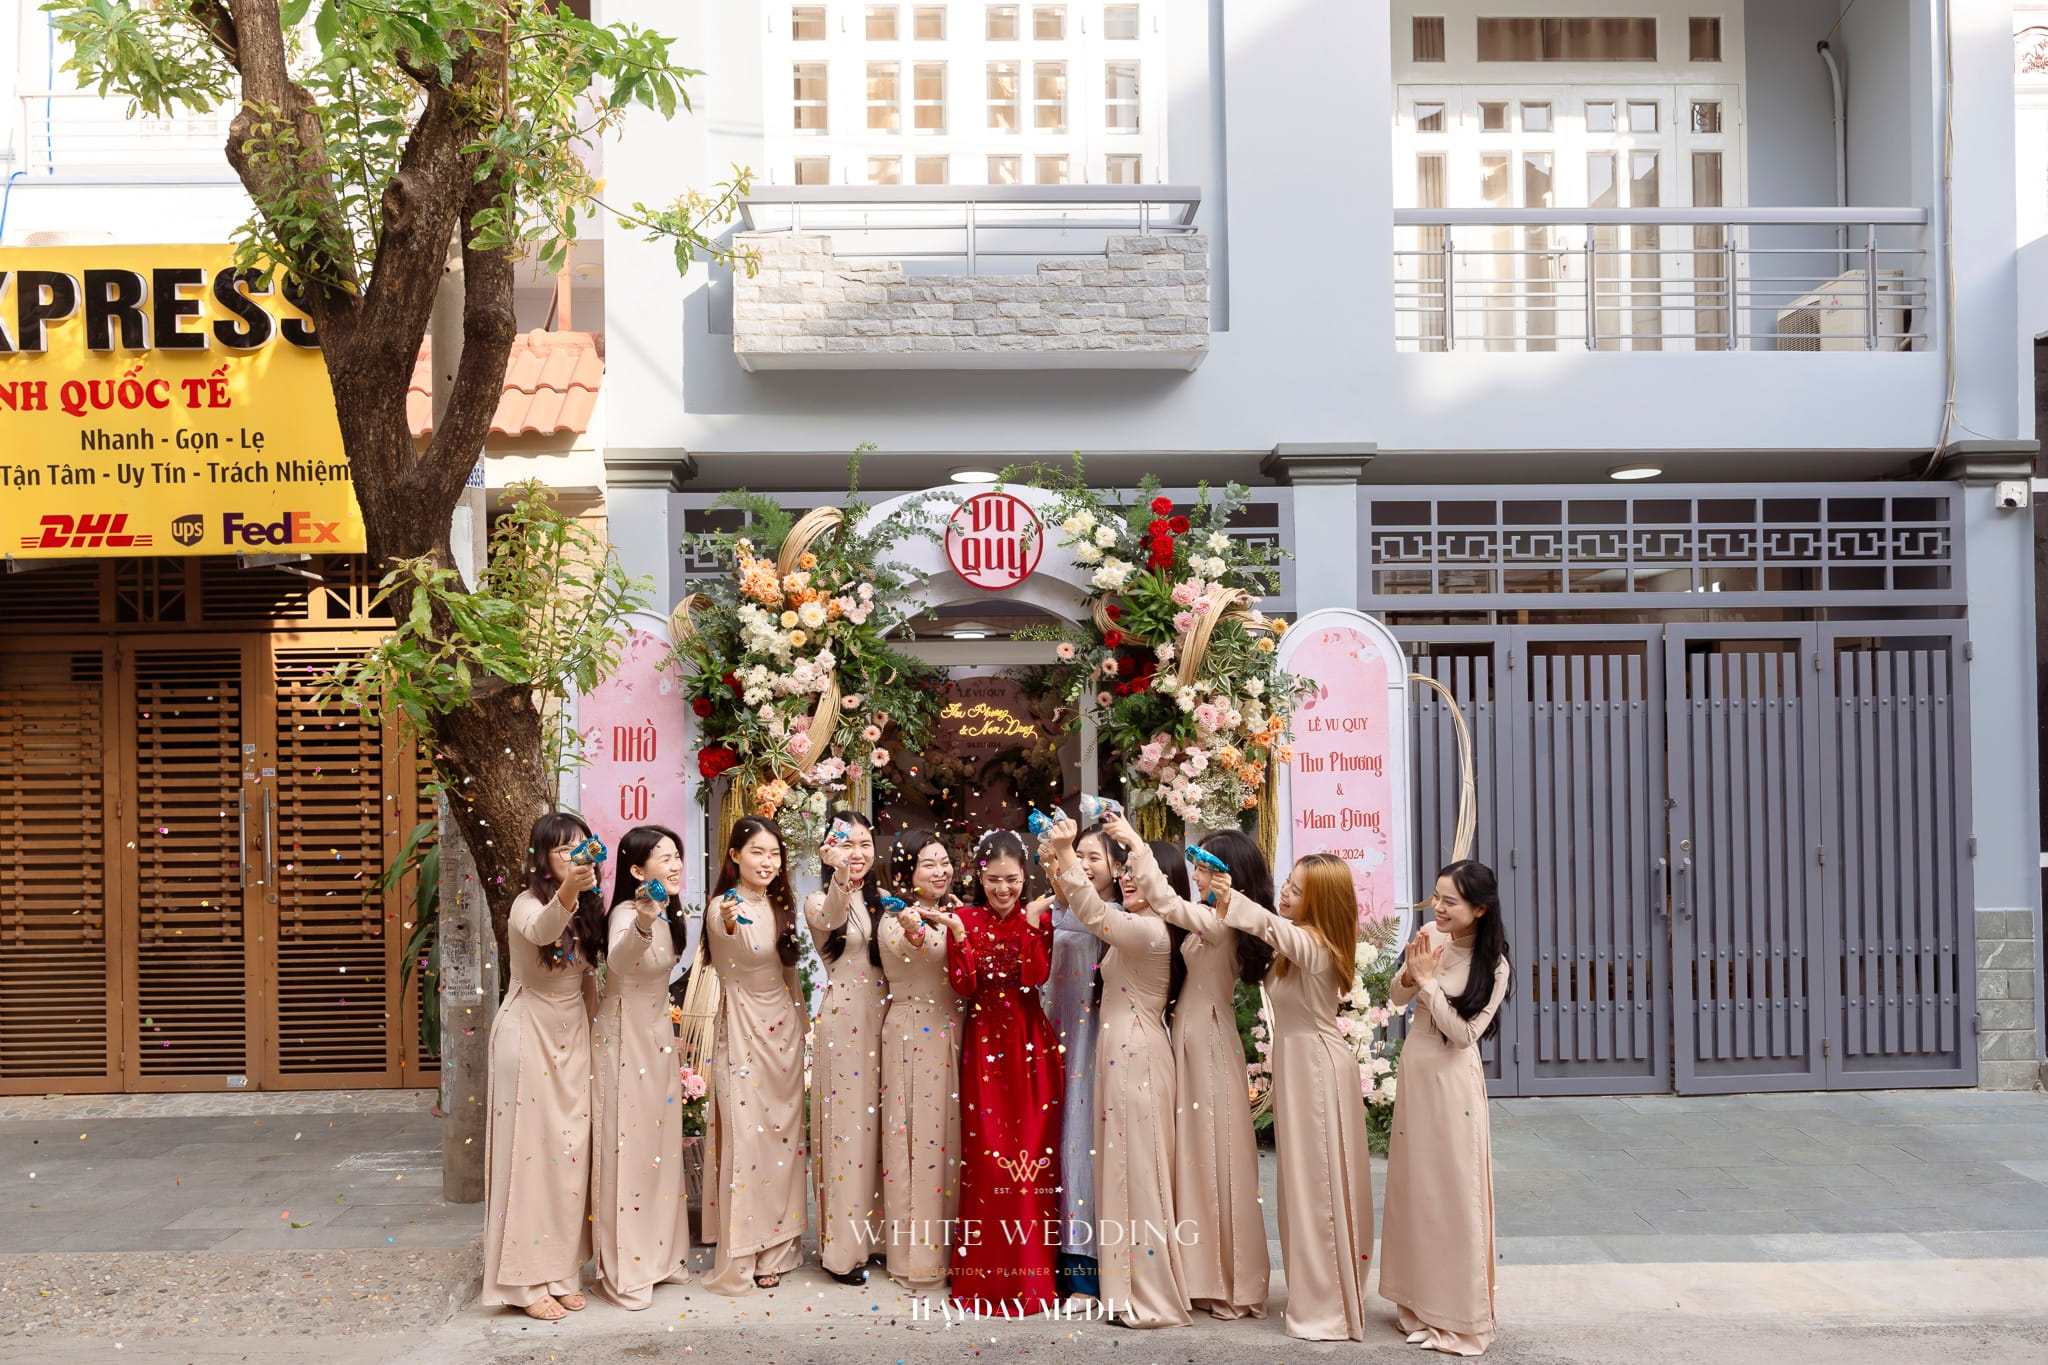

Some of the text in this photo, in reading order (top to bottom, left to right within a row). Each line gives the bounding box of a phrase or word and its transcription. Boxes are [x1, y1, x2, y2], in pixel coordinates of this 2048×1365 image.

[0, 267, 321, 353] PRESS
[60, 365, 170, 418] QUỐC
[181, 364, 232, 409] TẾ
[81, 428, 154, 451] Nhanh
[175, 428, 219, 454] Gọn
[240, 427, 265, 453] Lẹ
[1, 465, 41, 490] Tận
[47, 464, 96, 486] Tâm
[117, 463, 145, 488] Uy
[151, 462, 186, 484] Tín
[207, 461, 269, 484] Trách
[275, 459, 348, 486] Nhiệm
[37, 514, 135, 548] DHL
[223, 512, 340, 545] FedEx
[1325, 718, 1340, 731] VU
[1342, 717, 1369, 733] QUY
[1299, 752, 1325, 773] Thu
[1336, 783, 1345, 795] &
